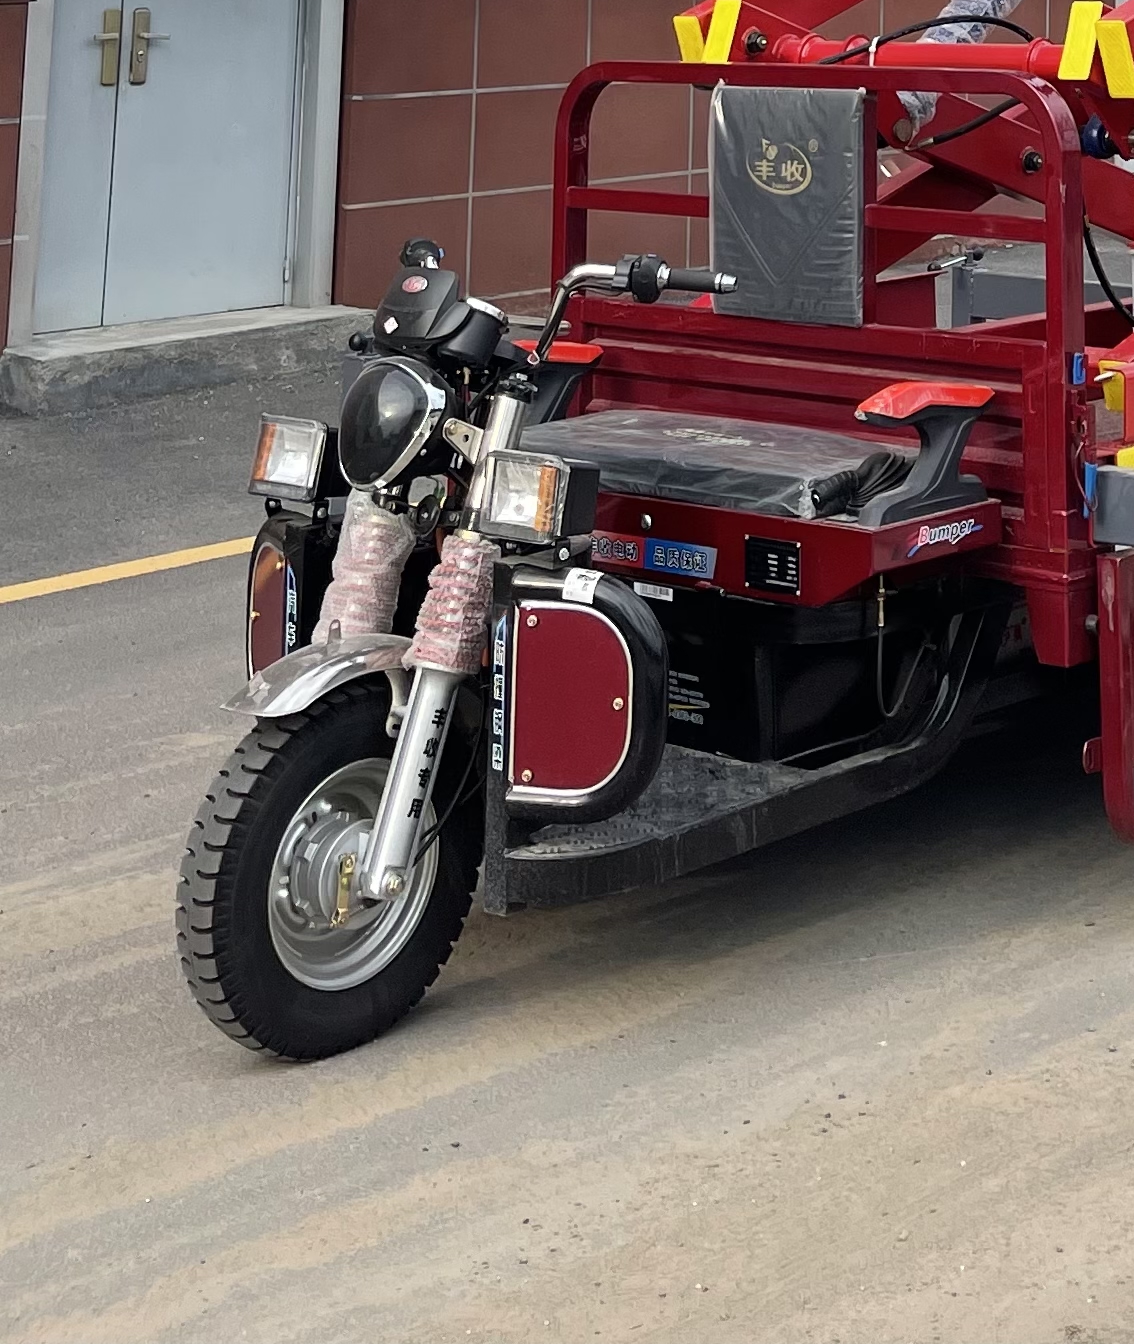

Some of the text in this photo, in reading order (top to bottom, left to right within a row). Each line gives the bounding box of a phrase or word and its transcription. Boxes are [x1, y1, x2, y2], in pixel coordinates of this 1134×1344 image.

[754, 159, 805, 182] 丰收
[918, 518, 975, 545] Bumper
[653, 545, 709, 573] 品质保证
[407, 707, 448, 820] 丰收专用
